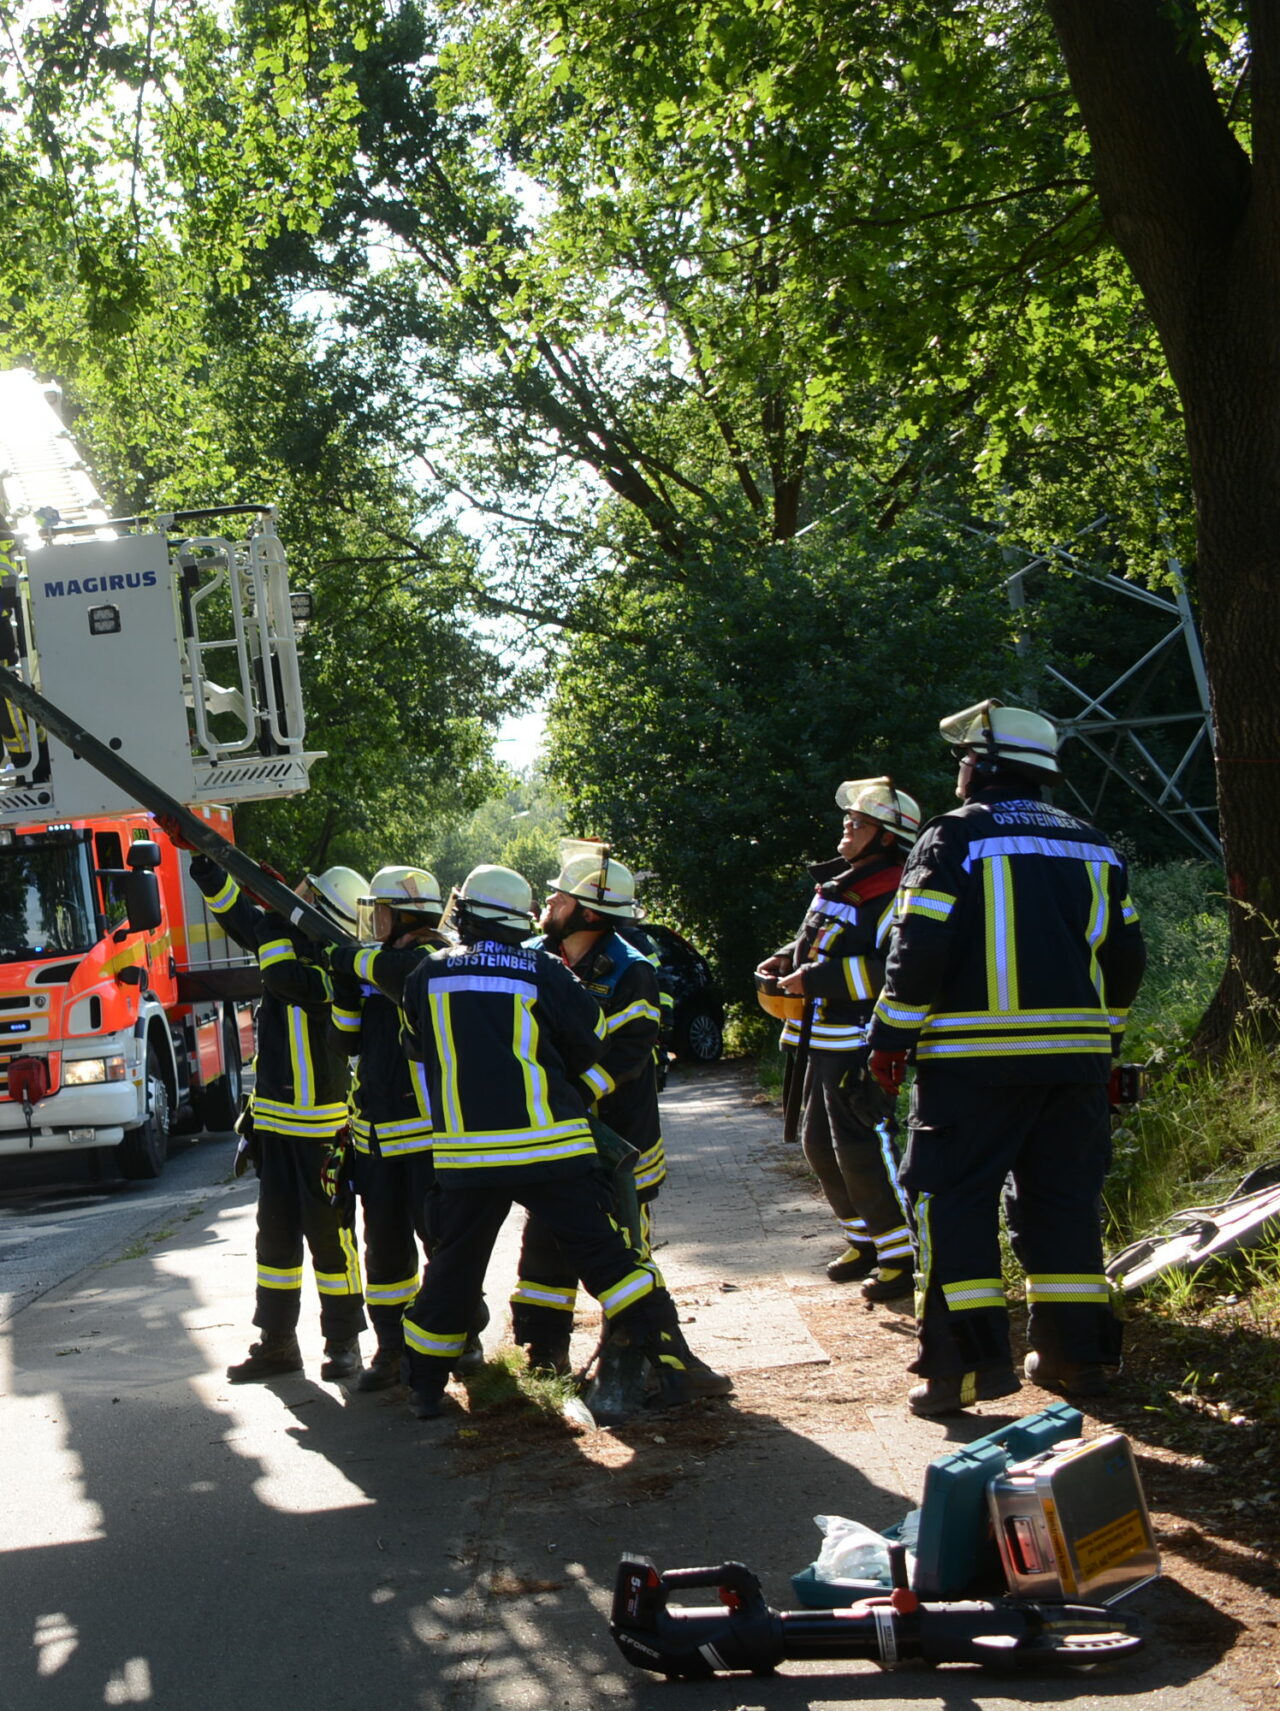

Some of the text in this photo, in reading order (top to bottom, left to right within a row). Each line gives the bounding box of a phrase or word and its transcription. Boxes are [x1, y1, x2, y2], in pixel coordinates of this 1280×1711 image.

[44, 571, 157, 598] MAGIRUS
[992, 812, 1082, 830] OSTSTEINBEK
[446, 952, 537, 973] OSTSTEINBEK
